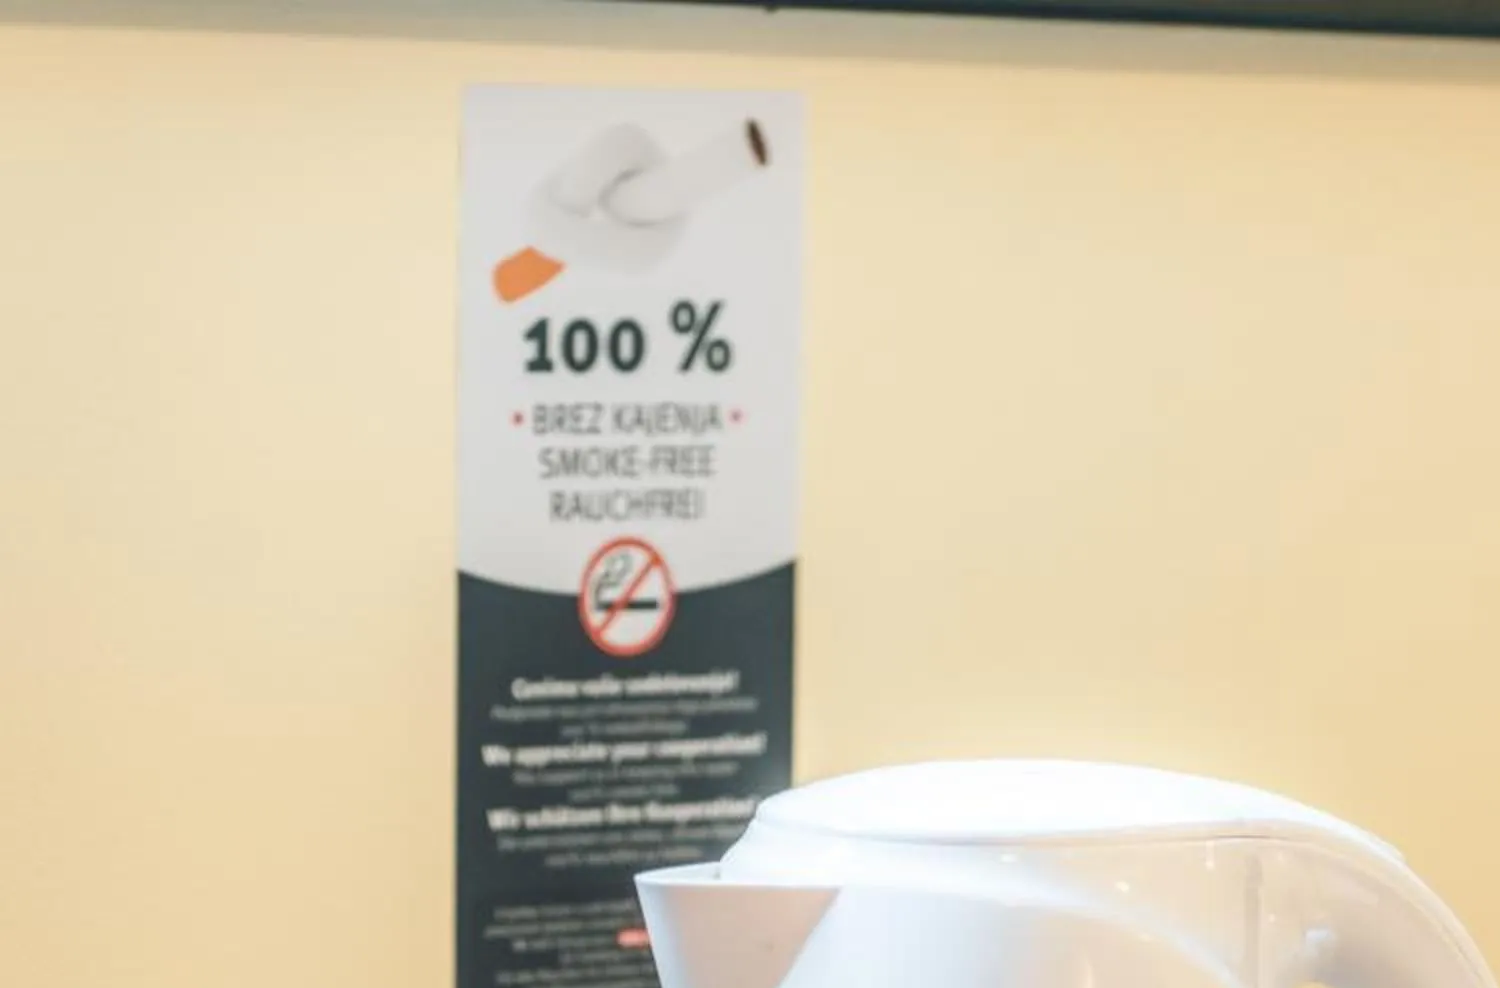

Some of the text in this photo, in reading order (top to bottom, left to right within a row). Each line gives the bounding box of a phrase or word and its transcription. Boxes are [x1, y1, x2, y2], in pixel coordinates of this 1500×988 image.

[522, 299, 732, 373] 100 %
[532, 402, 723, 435] BREZ KAJENJA
[538, 445, 717, 479] SMOKE-FREE
[550, 489, 706, 521] RAUCHFREI
